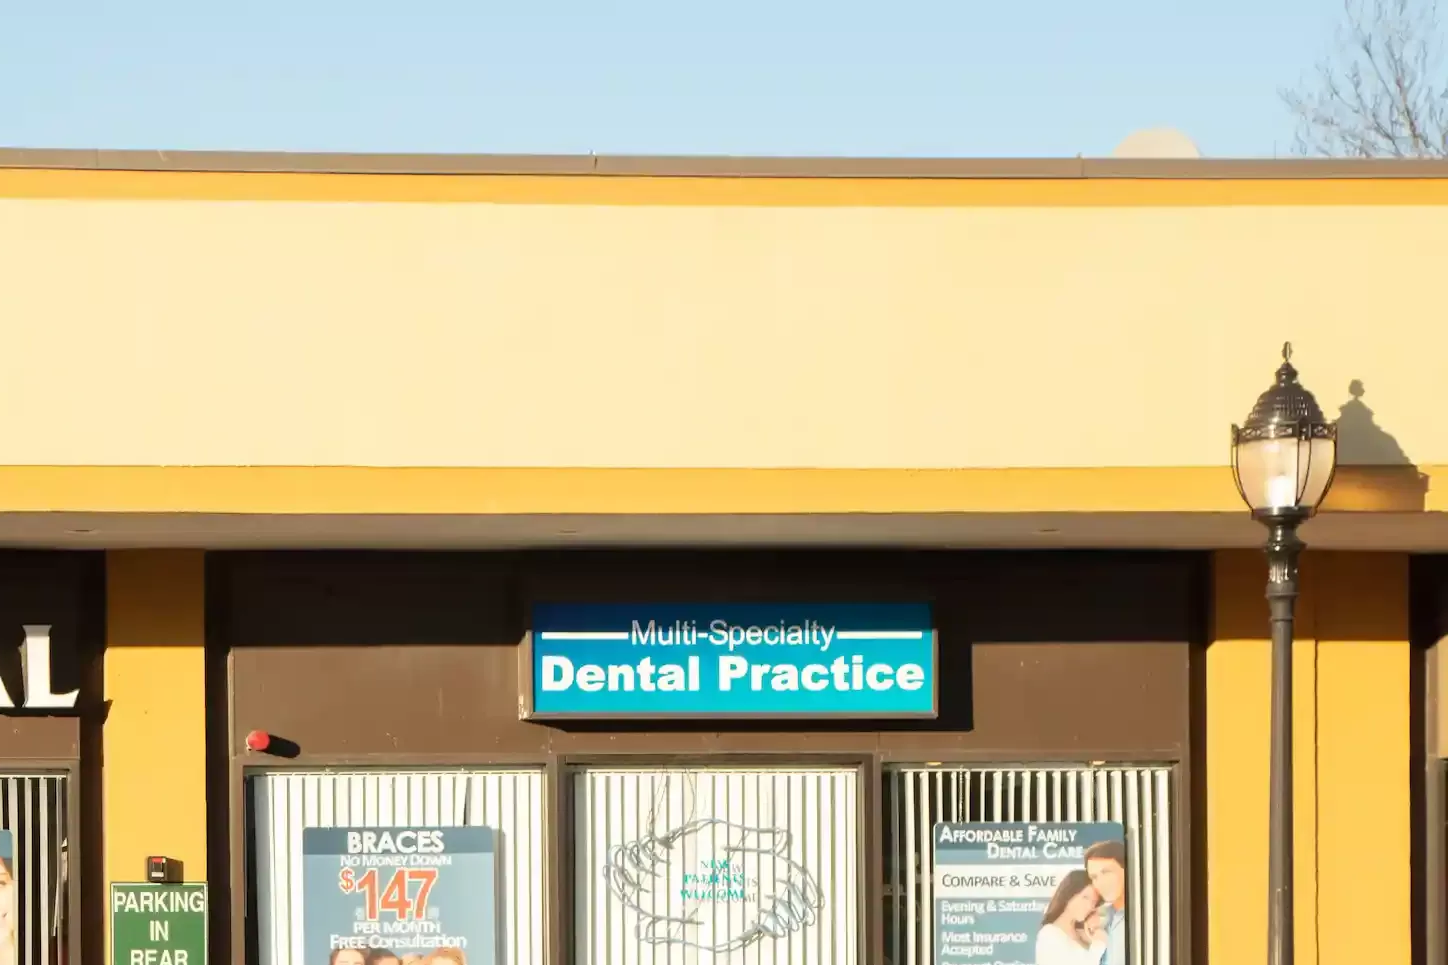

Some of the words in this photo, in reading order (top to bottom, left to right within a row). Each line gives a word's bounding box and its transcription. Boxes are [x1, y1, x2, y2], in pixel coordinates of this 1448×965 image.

[631, 619, 835, 651] Multi-Specialty
[541, 655, 700, 692] Dental
[719, 655, 924, 692] Practice
[347, 831, 445, 853] BRACES
[940, 825, 1023, 843] AFFORDABLE
[1028, 825, 1077, 842] FAMILY
[987, 842, 1039, 859] DENTAL
[1043, 842, 1084, 858] CARE
[340, 856, 360, 866] NO
[362, 856, 408, 867] MONEY
[410, 855, 452, 866] DOWN
[942, 873, 1005, 888] COMPARE
[1009, 875, 1020, 887] &
[1024, 873, 1057, 887] SAVE
[114, 891, 205, 913] PARKING
[338, 867, 439, 921] $147
[941, 900, 985, 914] Evening
[941, 913, 975, 925] Hours
[149, 920, 169, 941] IN
[353, 922, 381, 933] PER
[383, 922, 441, 934] MONTH
[329, 935, 367, 949] FREE
[369, 934, 468, 948] Consultation
[941, 932, 971, 943] Most
[973, 931, 1028, 943] Insurance
